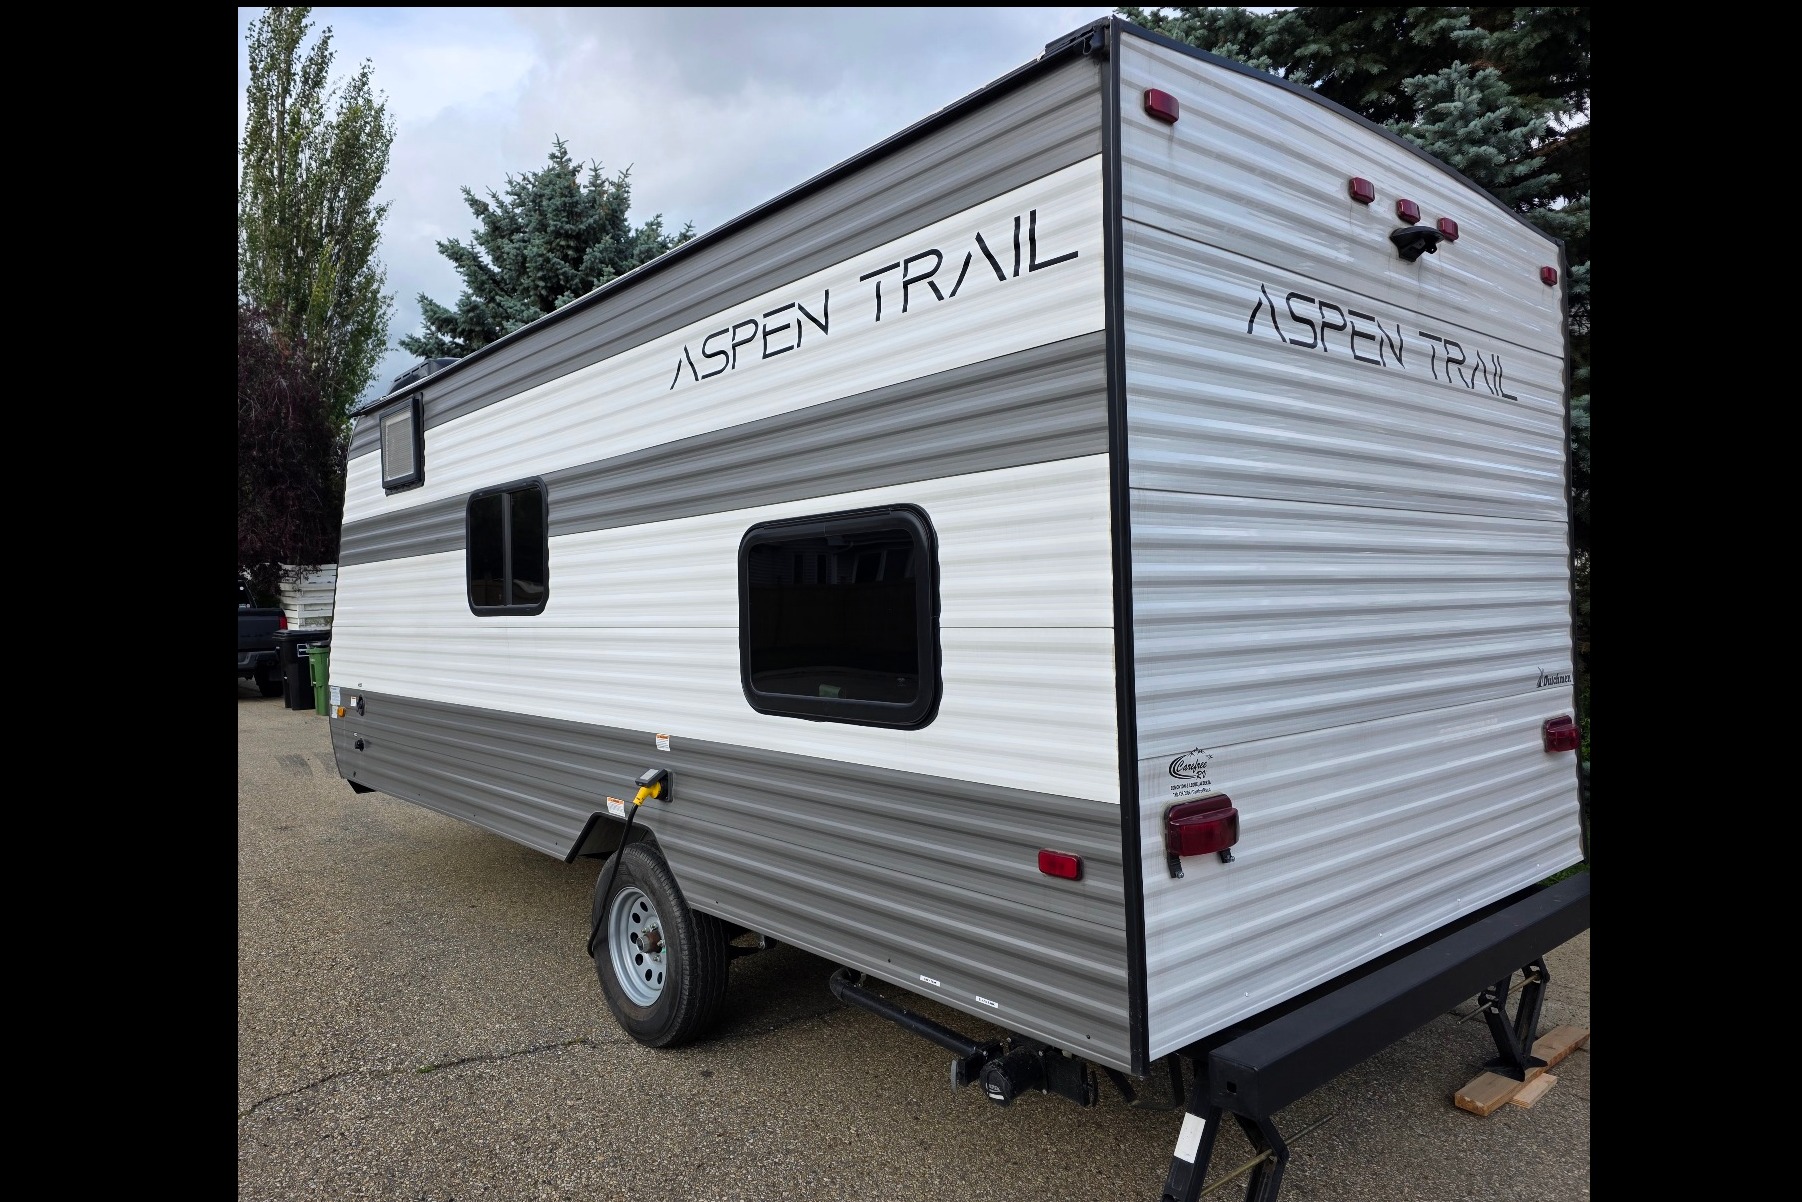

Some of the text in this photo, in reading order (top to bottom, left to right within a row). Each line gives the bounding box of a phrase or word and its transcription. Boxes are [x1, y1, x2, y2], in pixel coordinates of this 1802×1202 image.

[669, 209, 1079, 391] ASPEN TRAIL
[1247, 283, 1518, 401] ASPEN TRAIL
